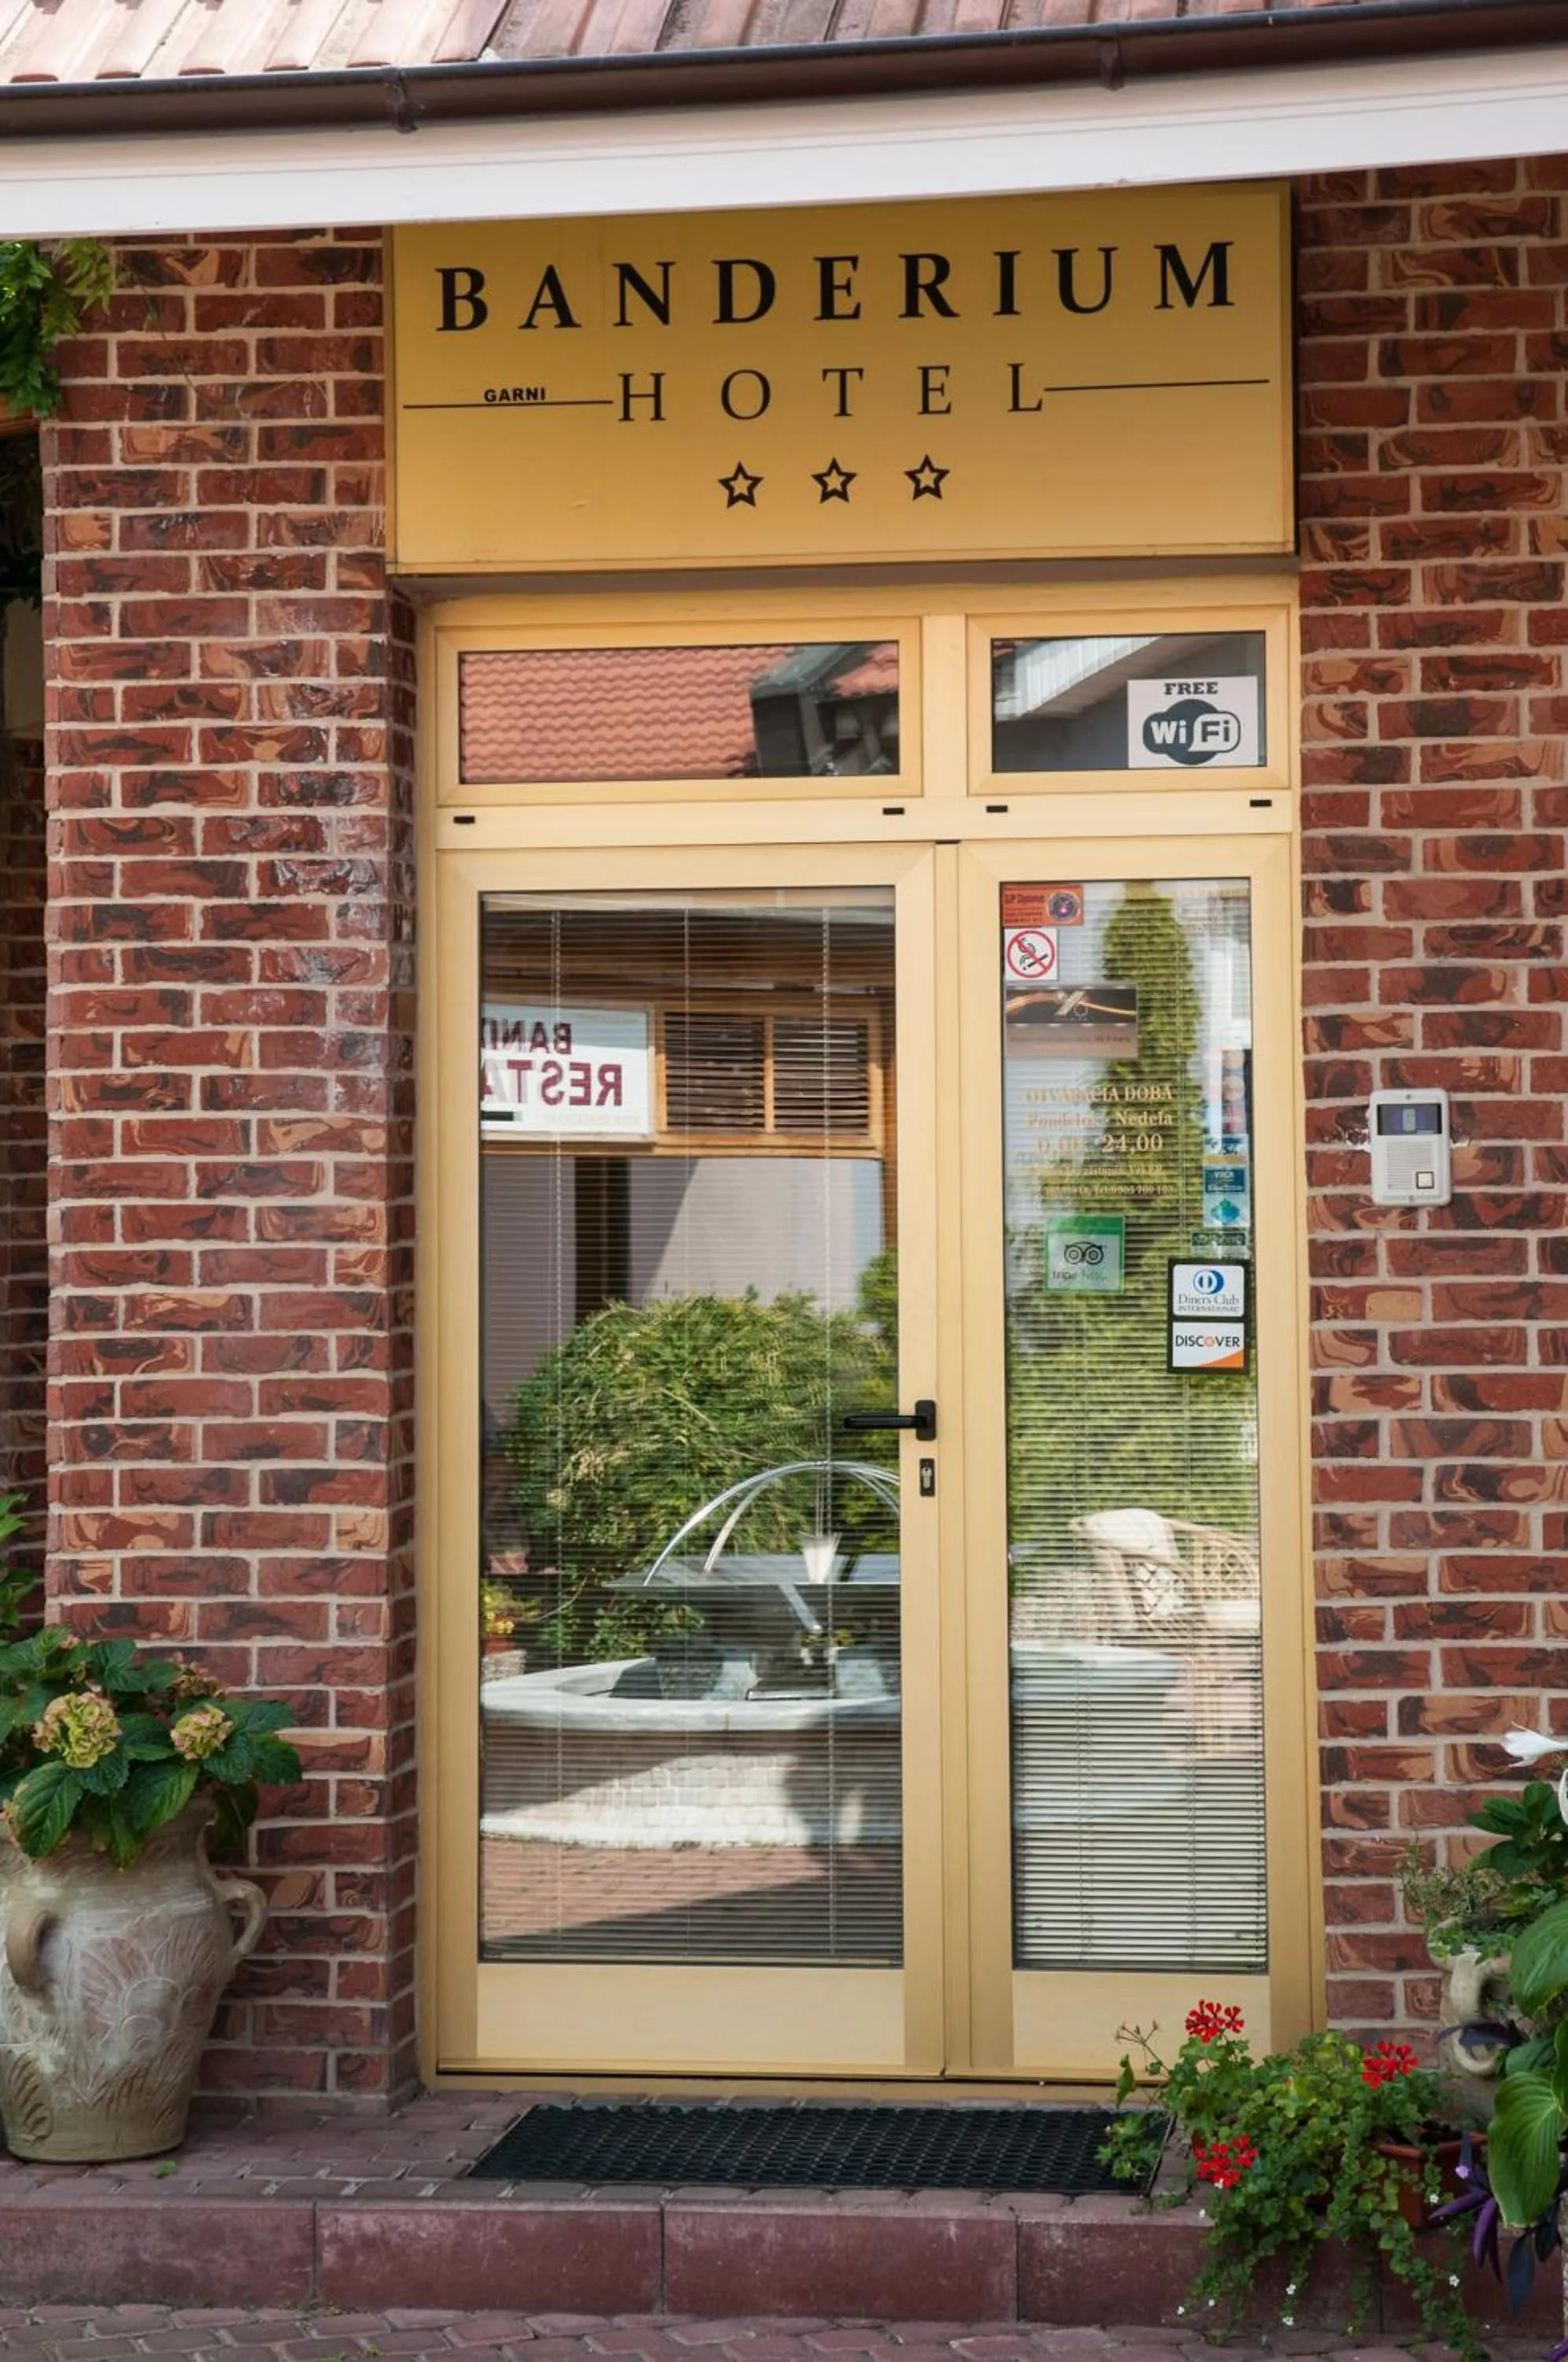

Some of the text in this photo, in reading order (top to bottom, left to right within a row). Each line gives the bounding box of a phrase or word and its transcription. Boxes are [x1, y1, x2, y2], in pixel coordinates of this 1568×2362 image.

[435, 241, 1234, 331] BANDERIUM
[483, 387, 545, 402] GARNI
[617, 362, 1042, 422] HOTEL
[1164, 681, 1219, 695] FREE
[1178, 1294, 1240, 1305] Diners Club
[1175, 1335, 1241, 1347] DISCOVER
